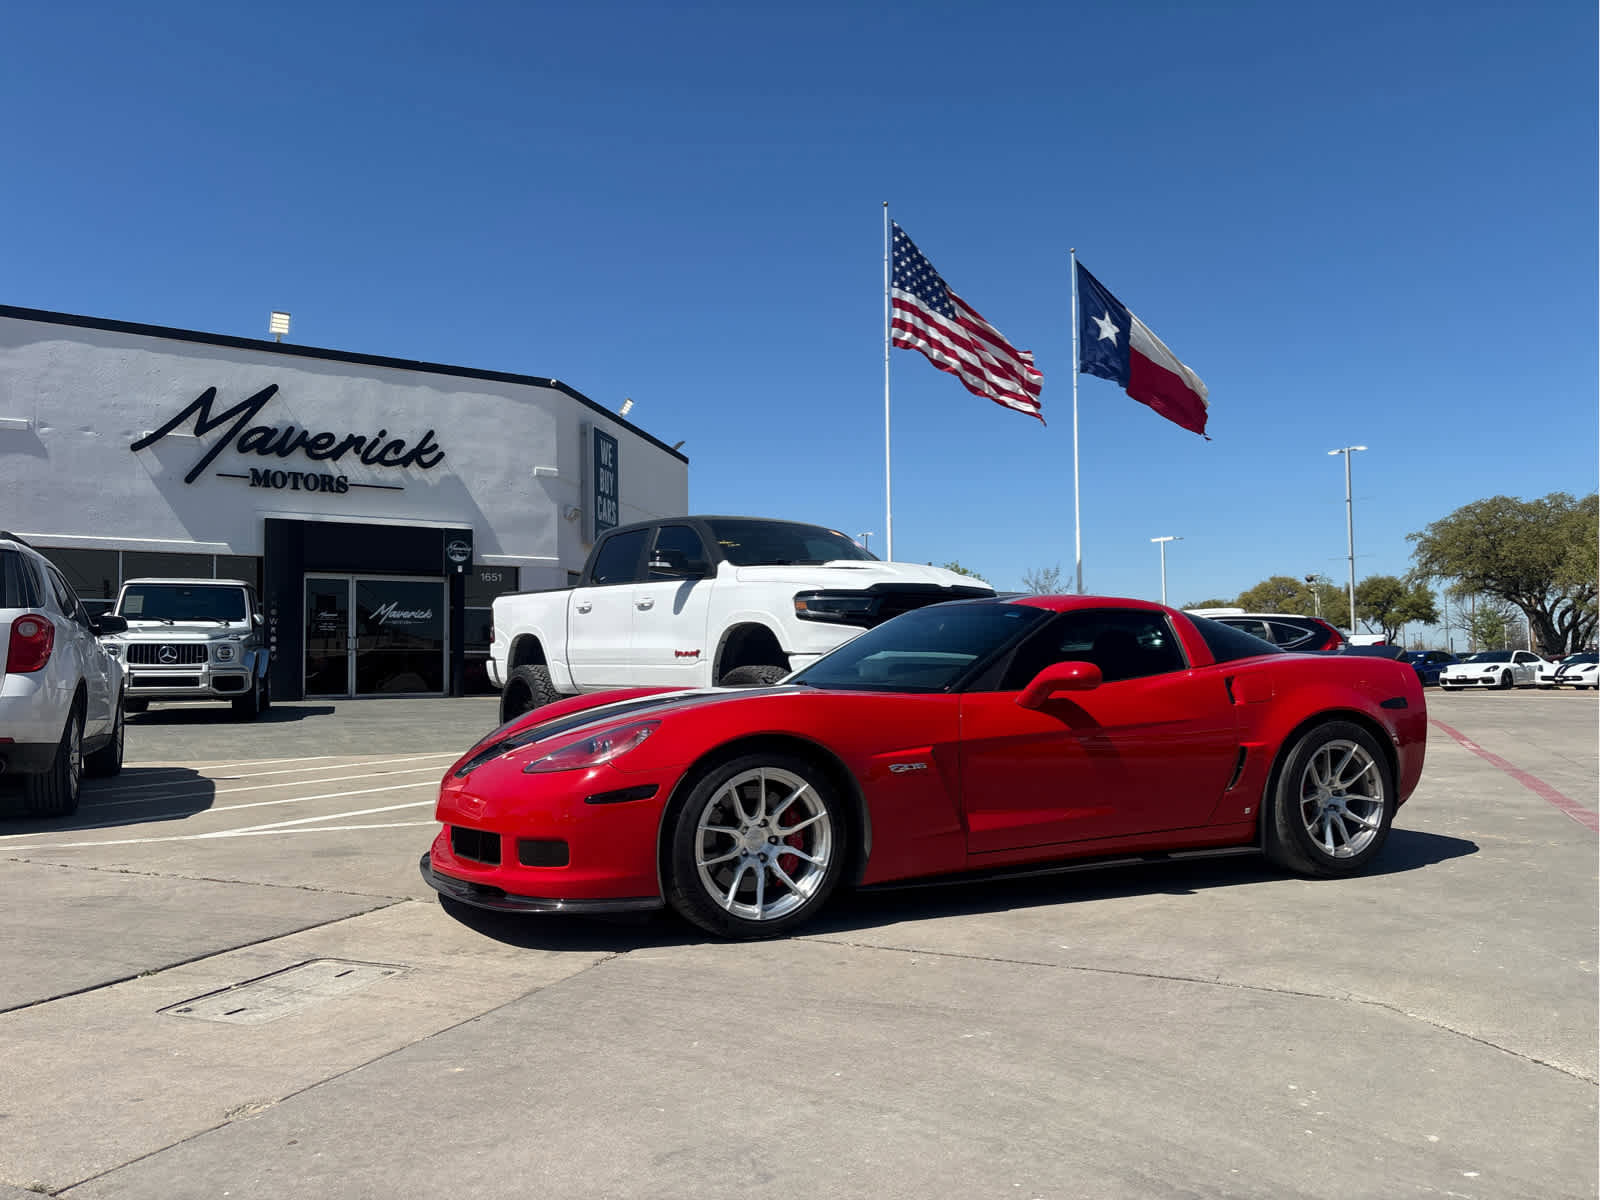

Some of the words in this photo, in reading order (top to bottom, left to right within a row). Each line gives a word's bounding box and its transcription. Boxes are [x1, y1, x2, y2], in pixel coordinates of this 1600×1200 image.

[130, 383, 445, 484] Maverick
[600, 439, 613, 468] WE
[249, 468, 349, 494] MOTORS
[600, 467, 614, 497] BUY
[597, 495, 617, 526] CARS
[480, 572, 503, 582] 1651
[368, 601, 433, 625] Maverick
